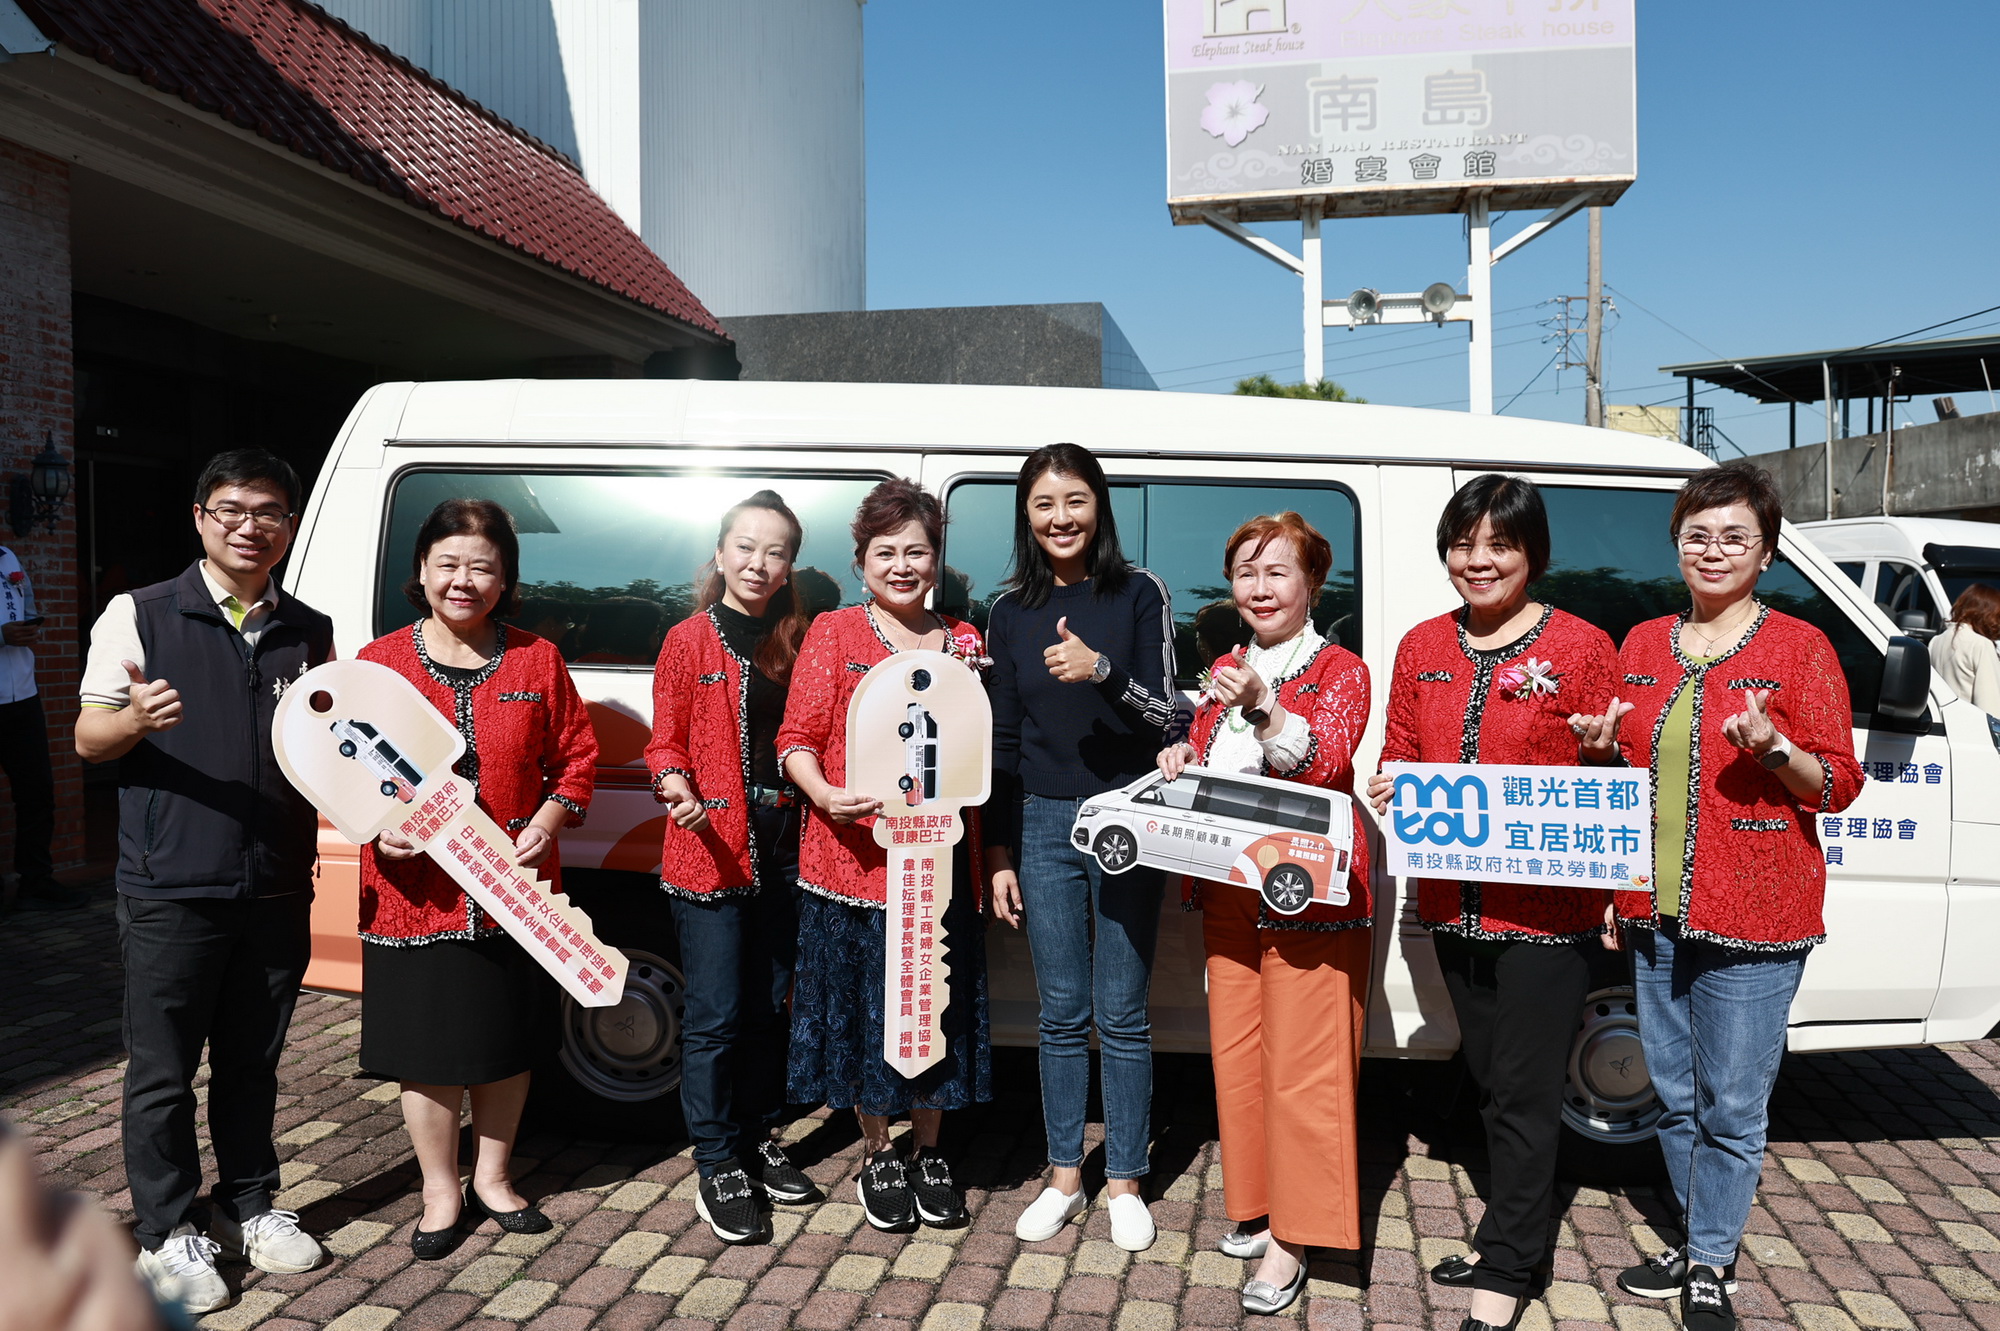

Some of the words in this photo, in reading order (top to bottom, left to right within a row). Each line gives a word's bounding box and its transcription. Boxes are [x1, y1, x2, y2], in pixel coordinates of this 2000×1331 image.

[1459, 23, 1526, 42] Steak
[1542, 19, 1615, 38] house
[1191, 42, 1240, 60] Elephant
[1242, 38, 1275, 55] Steak
[1275, 37, 1305, 52] house
[1306, 69, 1492, 136] 南島
[1276, 143, 1321, 156] NAN
[1328, 141, 1371, 153] DAO
[1380, 132, 1529, 152] RESTAURANT
[1301, 150, 1497, 185] 婚宴會館
[1502, 775, 1640, 811] 觀光首都
[399, 780, 458, 837] 南投縣政府
[415, 797, 464, 842] 復康巴士
[885, 814, 953, 830] 南投縣政府
[891, 829, 946, 844] 復康巴士
[1160, 823, 1232, 849] 長期照顧專車
[1504, 820, 1641, 856] 宜居城市
[1822, 816, 1918, 840] 管理協會
[1290, 836, 1325, 851] 長照2.0
[1406, 851, 1630, 881] 南投縣政府社會及勞動處
[460, 825, 616, 981] 中華民國工商婦女企業管理協會
[917, 858, 935, 1058] 南投縣工商婦女企業管理協會
[577, 966, 605, 996] 捐贈
[898, 1031, 913, 1059] 捐贈
